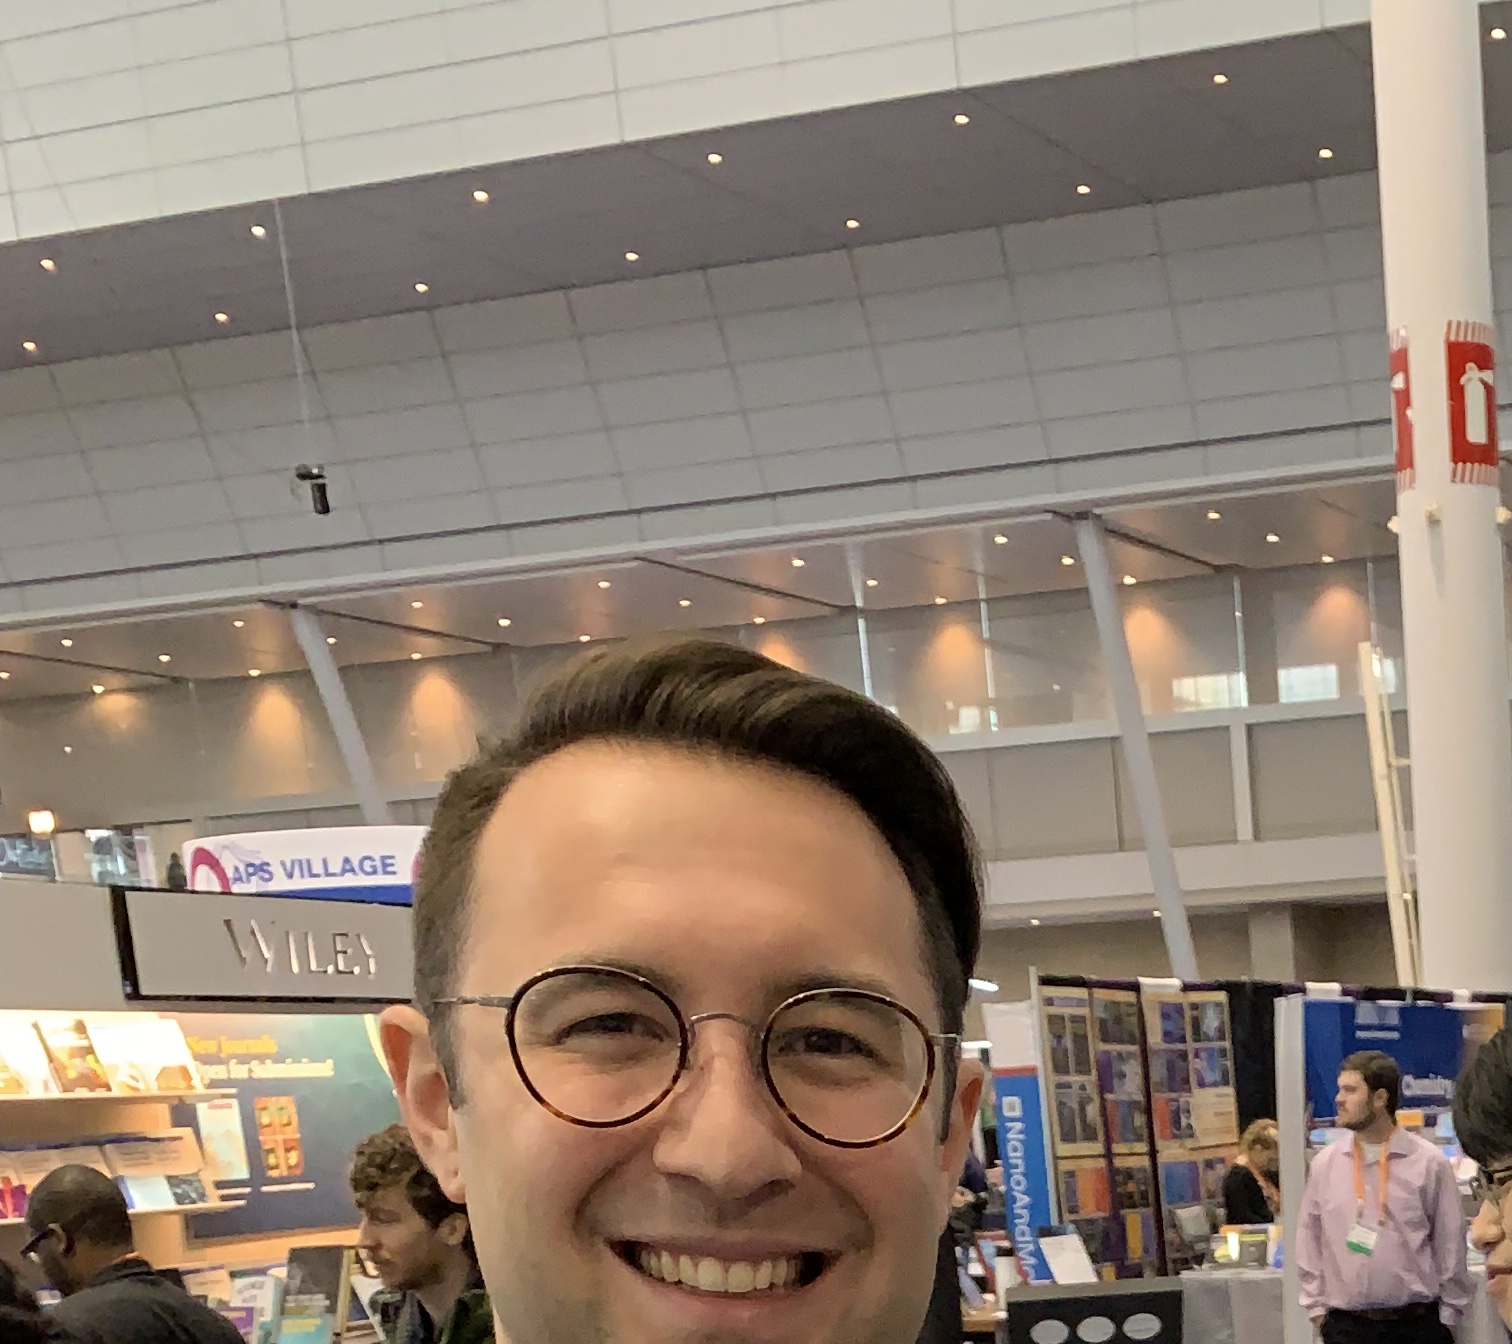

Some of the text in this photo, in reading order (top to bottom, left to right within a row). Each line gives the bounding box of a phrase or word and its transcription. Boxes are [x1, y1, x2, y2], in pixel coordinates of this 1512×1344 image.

[231, 854, 398, 886] APS VILLAGE
[223, 917, 379, 978] WILEY
